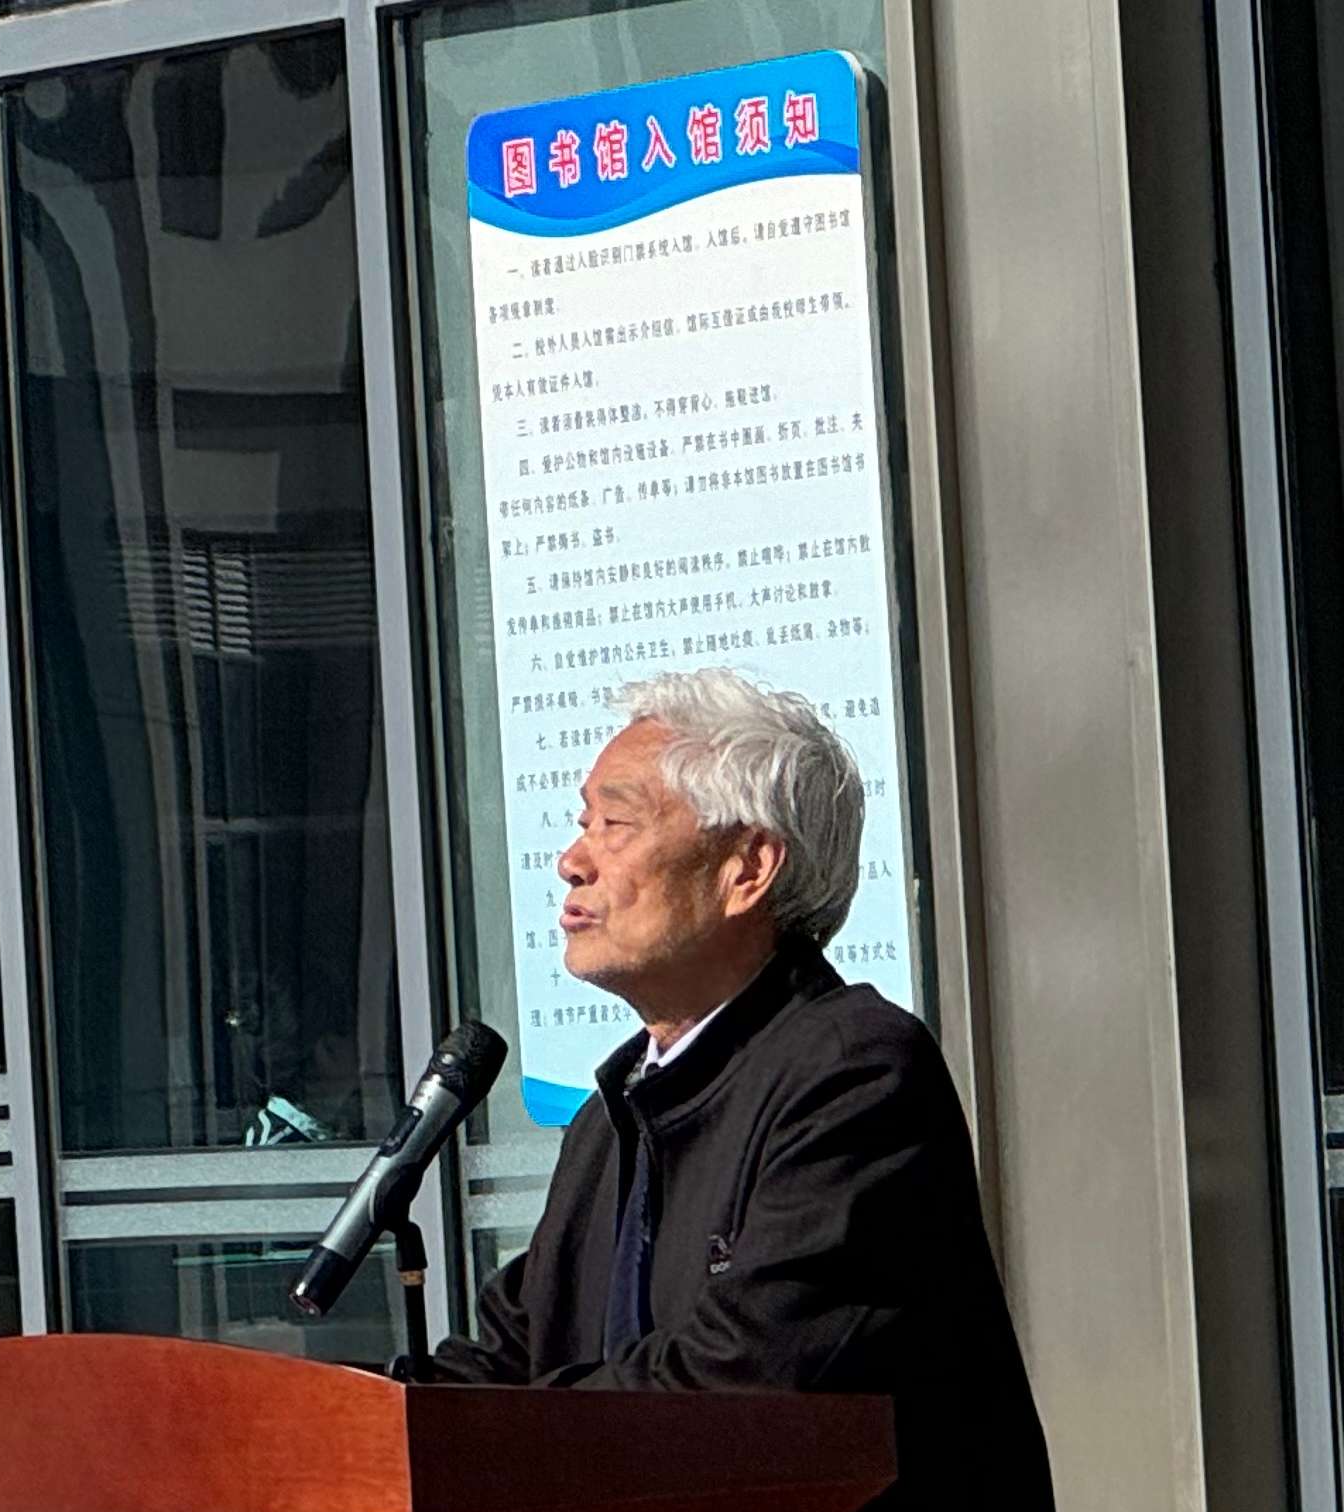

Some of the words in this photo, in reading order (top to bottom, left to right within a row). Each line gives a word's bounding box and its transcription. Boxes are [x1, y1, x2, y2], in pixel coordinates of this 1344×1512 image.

[502, 92, 821, 199] 图书馆入馆须知
